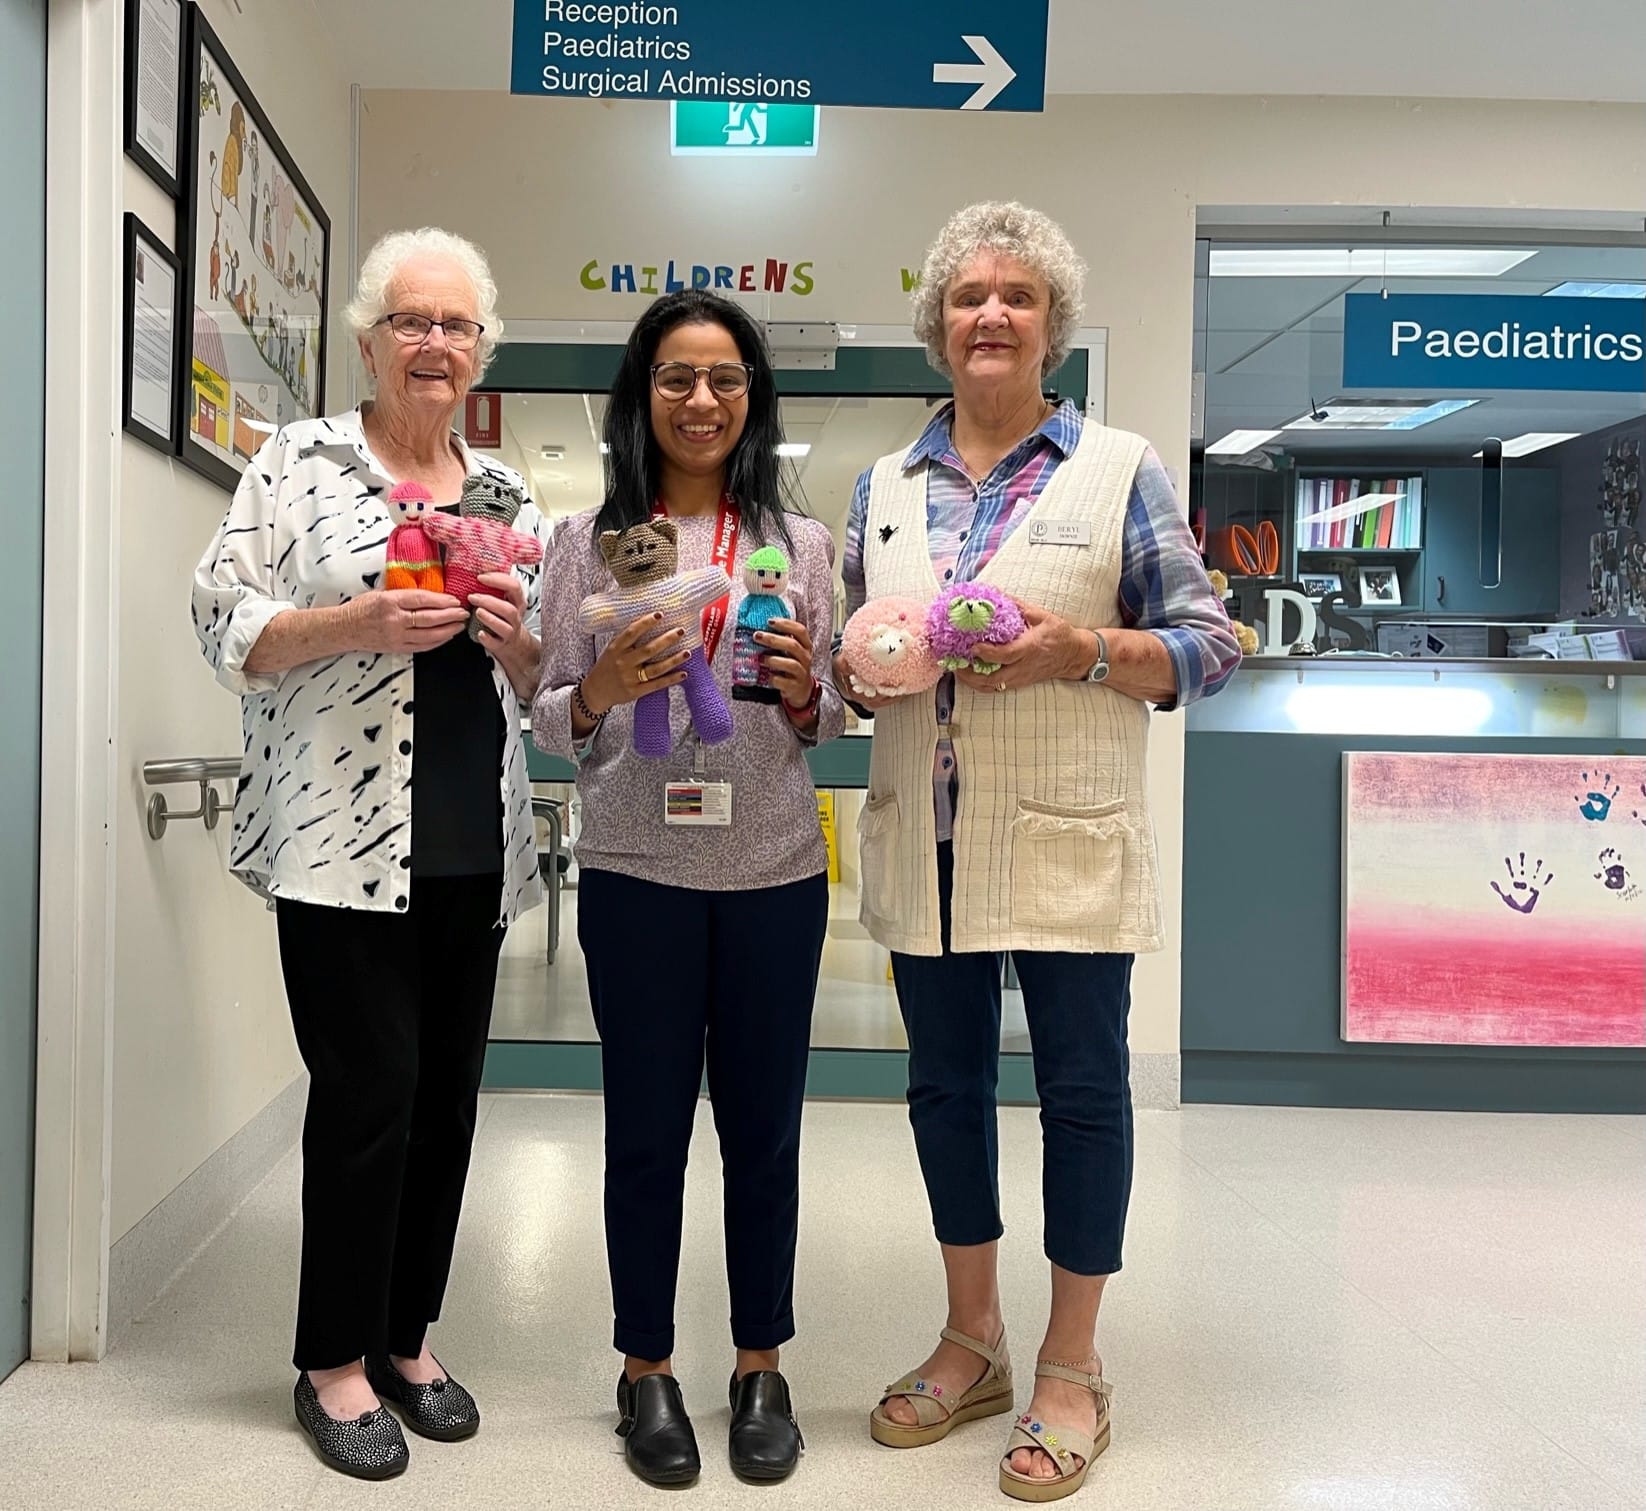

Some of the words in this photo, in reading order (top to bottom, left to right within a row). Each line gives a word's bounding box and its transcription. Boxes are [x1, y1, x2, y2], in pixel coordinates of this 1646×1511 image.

[545, 0, 677, 29] Reception
[544, 31, 691, 60] Paediatrics
[542, 65, 648, 97] Surgical
[657, 69, 811, 98] Admissions
[580, 259, 814, 295] CHILDRENS
[1391, 320, 1644, 361] Paediatrics
[716, 511, 735, 558] Manager
